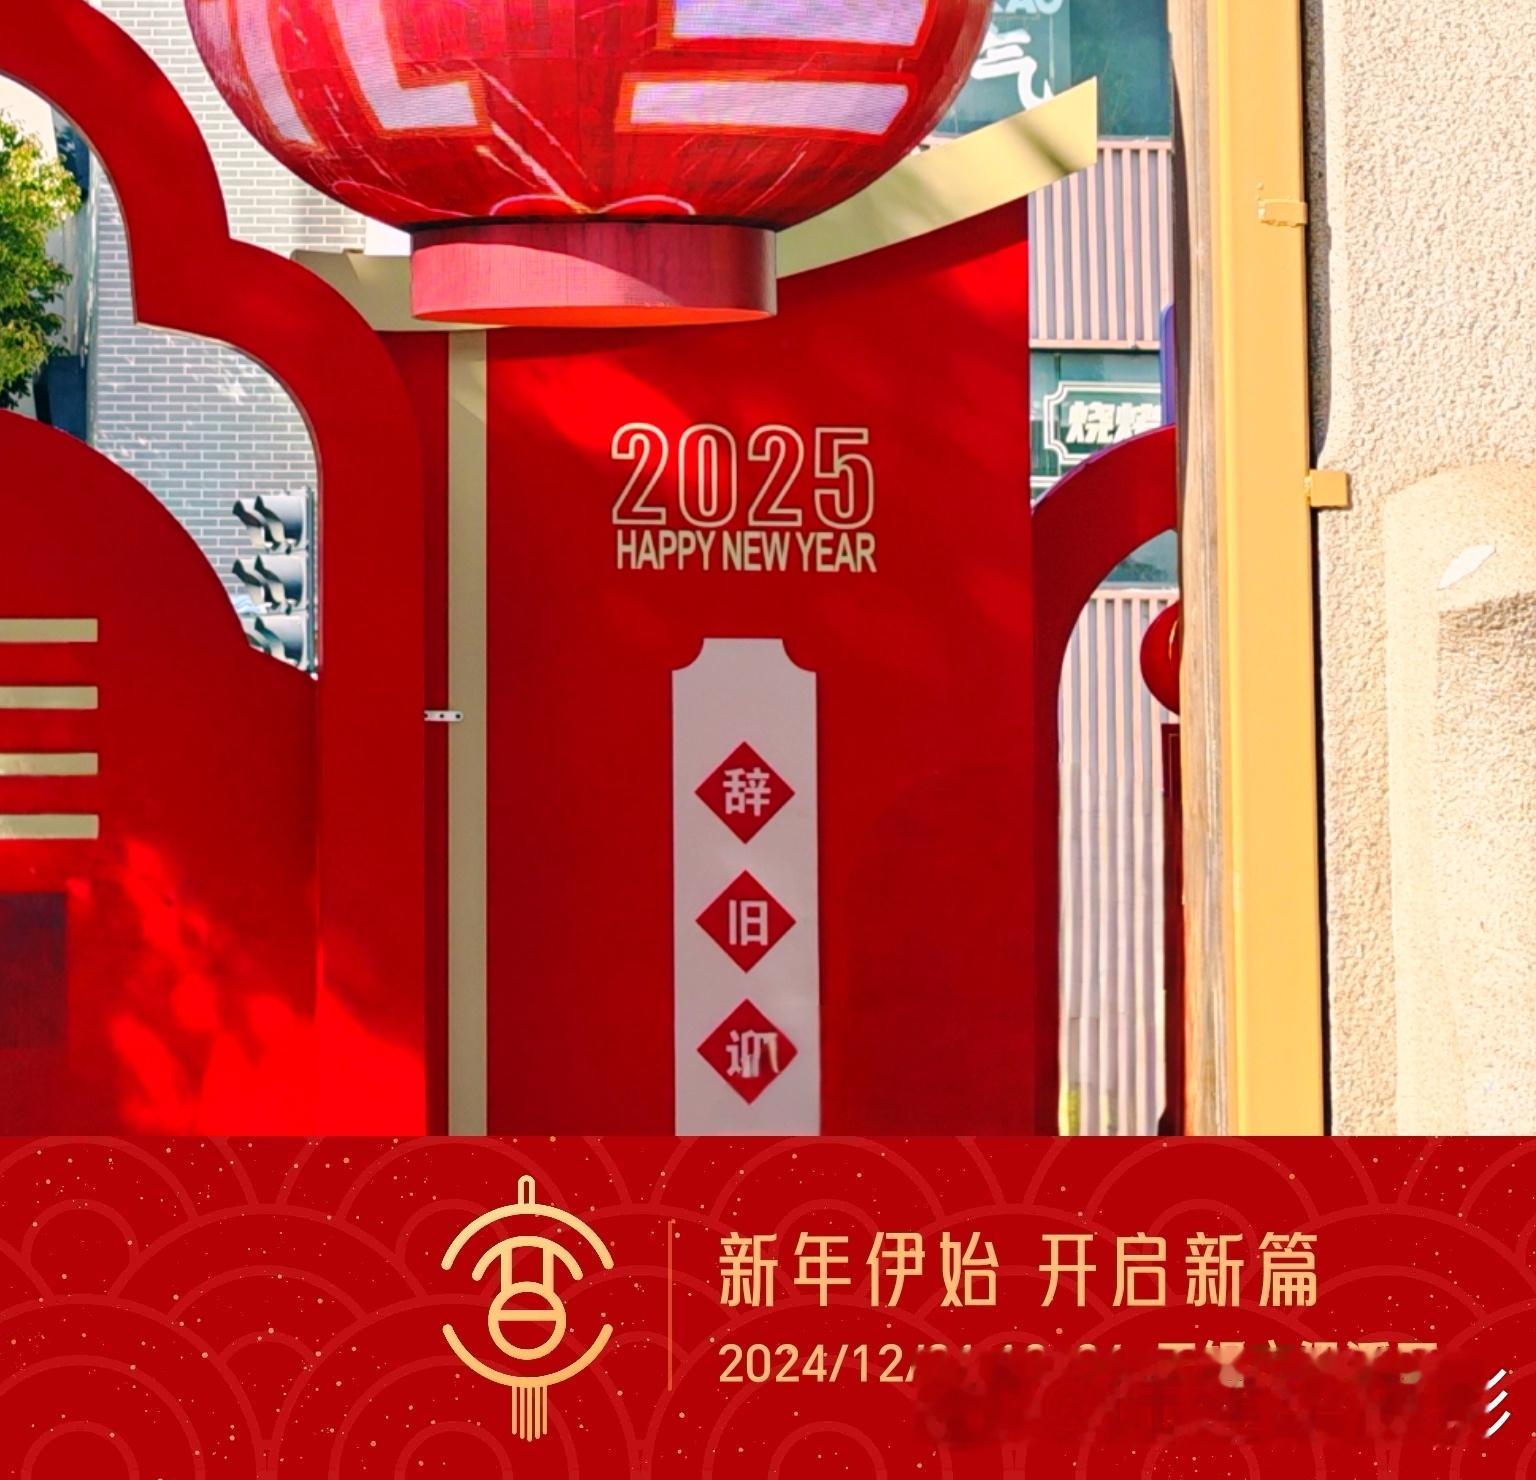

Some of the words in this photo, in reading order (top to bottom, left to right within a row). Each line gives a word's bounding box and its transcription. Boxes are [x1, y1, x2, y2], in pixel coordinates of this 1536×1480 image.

[611, 422, 875, 530] 2025
[616, 529, 715, 570] HAPPY
[722, 530, 790, 572] NEW
[796, 531, 877, 573] YEAR
